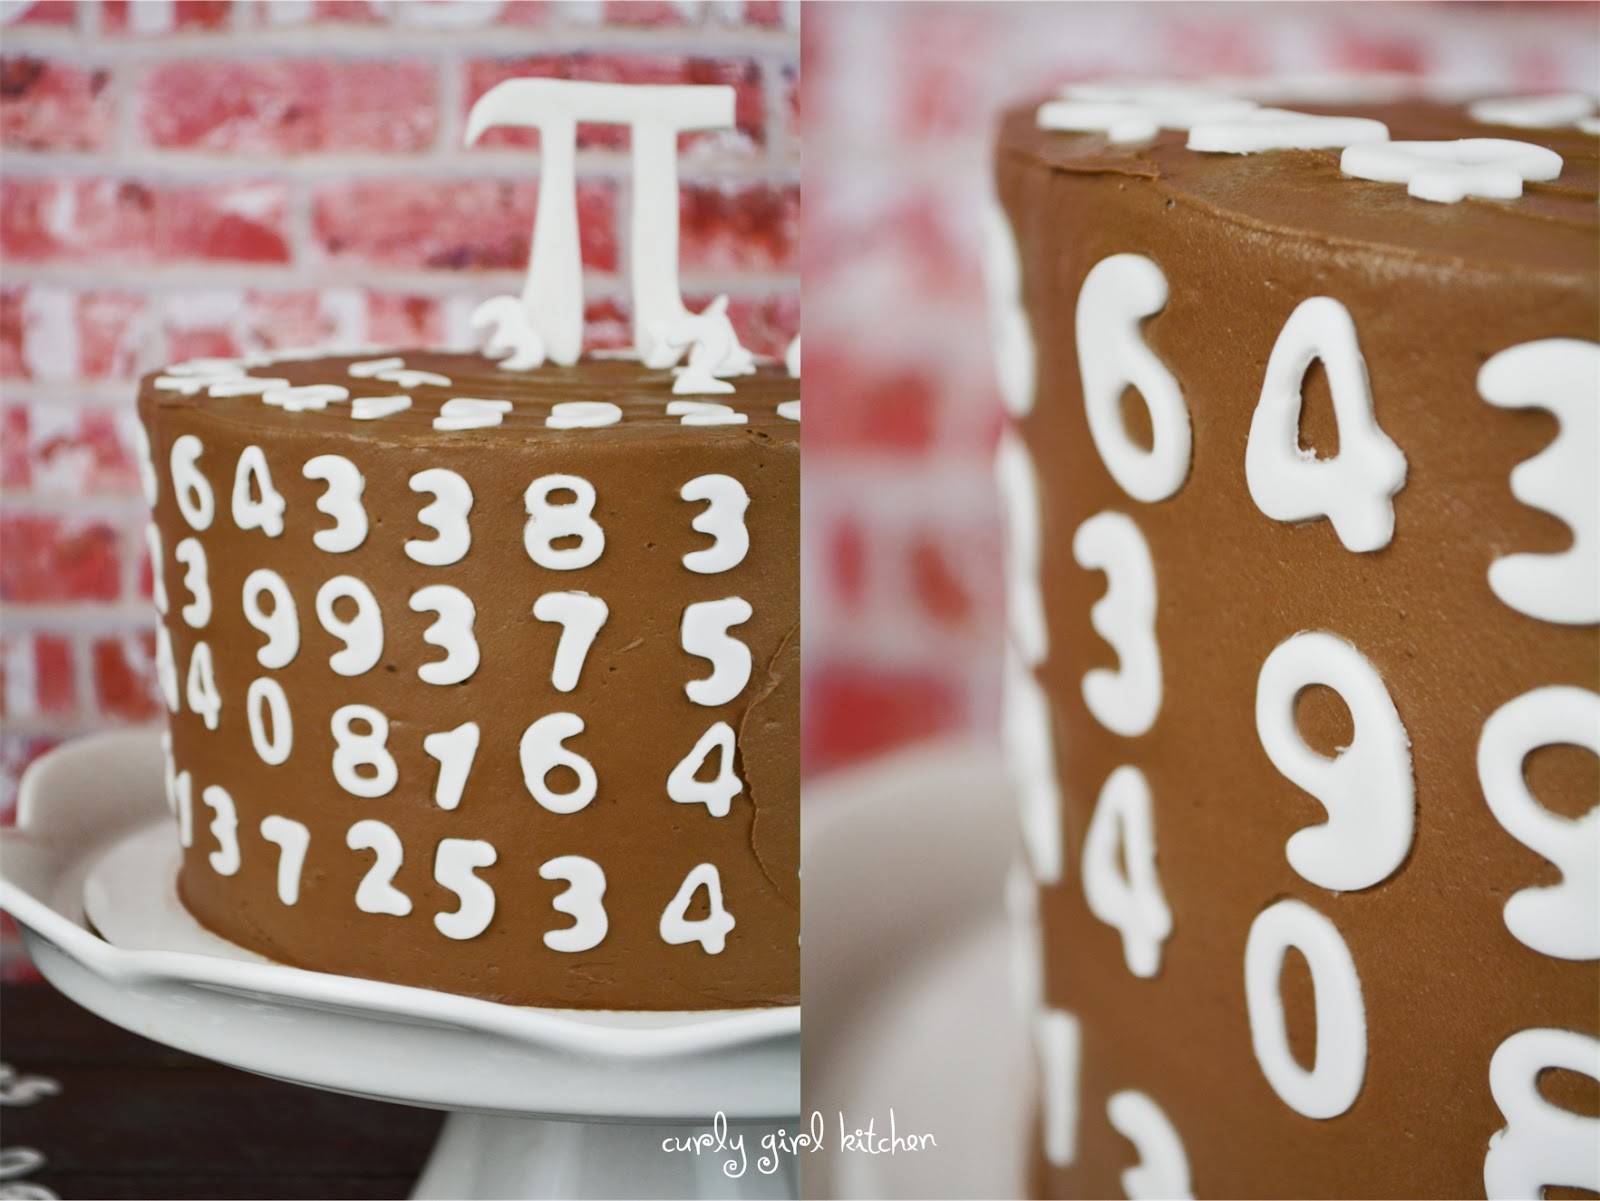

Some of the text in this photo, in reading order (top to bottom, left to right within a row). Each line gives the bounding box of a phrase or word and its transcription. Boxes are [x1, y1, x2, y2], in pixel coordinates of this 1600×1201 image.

[1075, 254, 1192, 503] 6
[1245, 296, 1408, 553] 4
[171, 435, 215, 531] 6
[231, 445, 286, 538] 4
[302, 454, 369, 553] 3
[404, 468, 474, 566] 3
[523, 473, 606, 571] 8
[680, 473, 751, 574] 3
[175, 537, 212, 629] 3
[242, 569, 300, 669] 9
[315, 575, 384, 677] 9
[408, 584, 481, 686] 3
[532, 590, 609, 693] 7
[680, 596, 753, 707] 5
[1073, 511, 1162, 737] 3
[1255, 630, 1415, 892] 9
[186, 641, 222, 730] 4
[331, 704, 399, 798] 8
[423, 721, 481, 811] 1
[519, 712, 598, 814] 6
[666, 721, 743, 818] 4
[202, 785, 241, 876] 3
[260, 815, 310, 906] 7
[346, 819, 413, 917] 2
[433, 838, 497, 940] 5
[539, 855, 609, 953] 3
[659, 863, 736, 955] 4
[1082, 766, 1173, 978] 4
